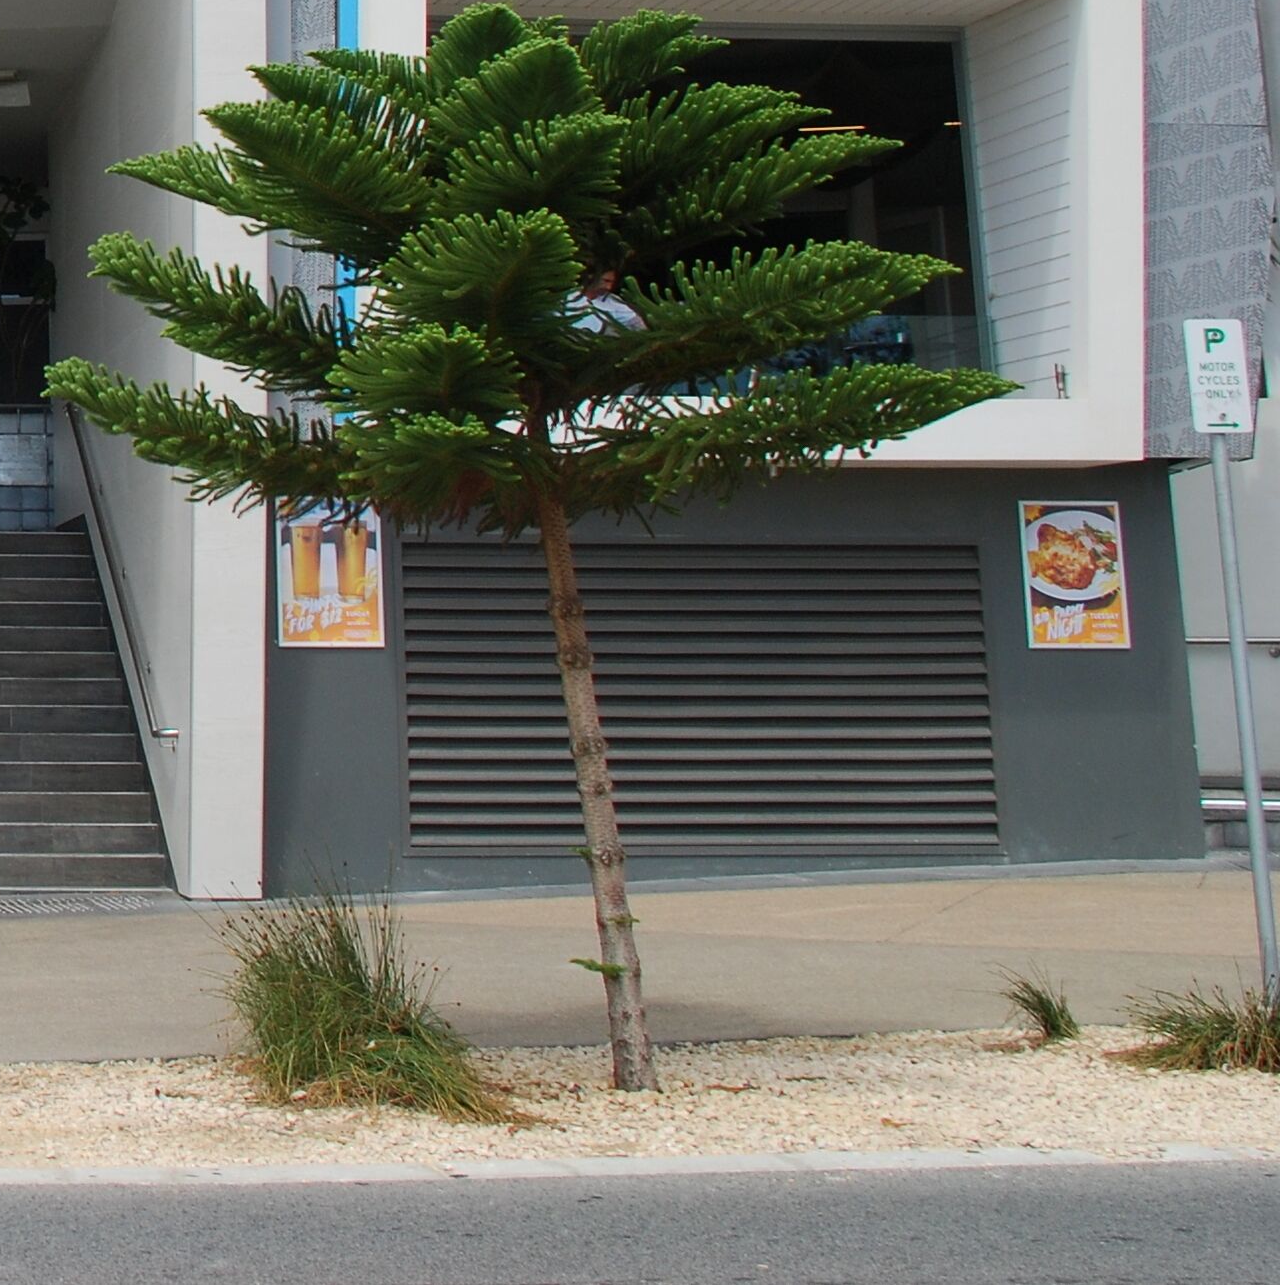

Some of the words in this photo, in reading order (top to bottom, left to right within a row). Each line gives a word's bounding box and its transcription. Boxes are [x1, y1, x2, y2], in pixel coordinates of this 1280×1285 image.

[1203, 328, 1226, 353] P
[1199, 362, 1236, 372] MOTOR
[1197, 375, 1240, 386] CYCLES
[1205, 389, 1235, 399] ONLY
